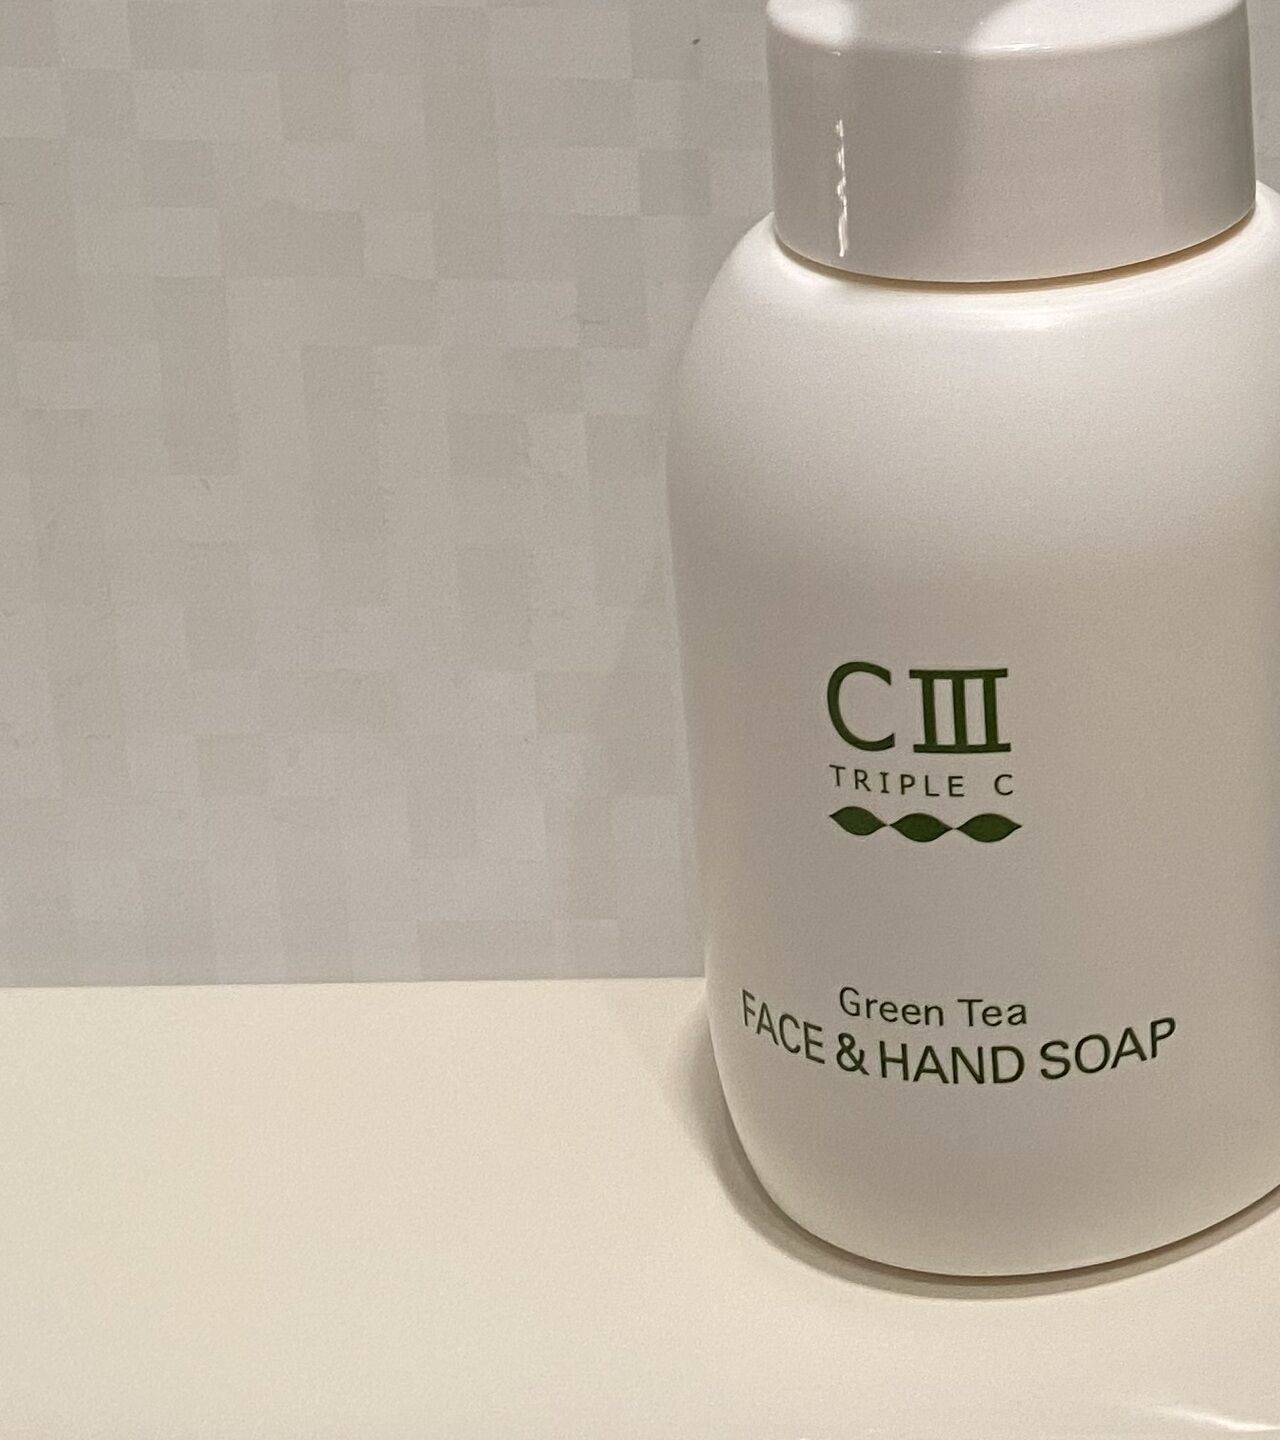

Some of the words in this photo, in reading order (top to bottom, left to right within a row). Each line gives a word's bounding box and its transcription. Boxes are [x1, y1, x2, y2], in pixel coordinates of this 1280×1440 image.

[829, 764, 965, 797] TRIPLE
[992, 773, 1014, 796] C
[839, 987, 944, 1027] Green
[958, 998, 1028, 1028] Tea
[742, 989, 826, 1064] FACE
[835, 1032, 870, 1076] &
[879, 1040, 1025, 1085] HAND
[1039, 1016, 1177, 1080] SOAP
